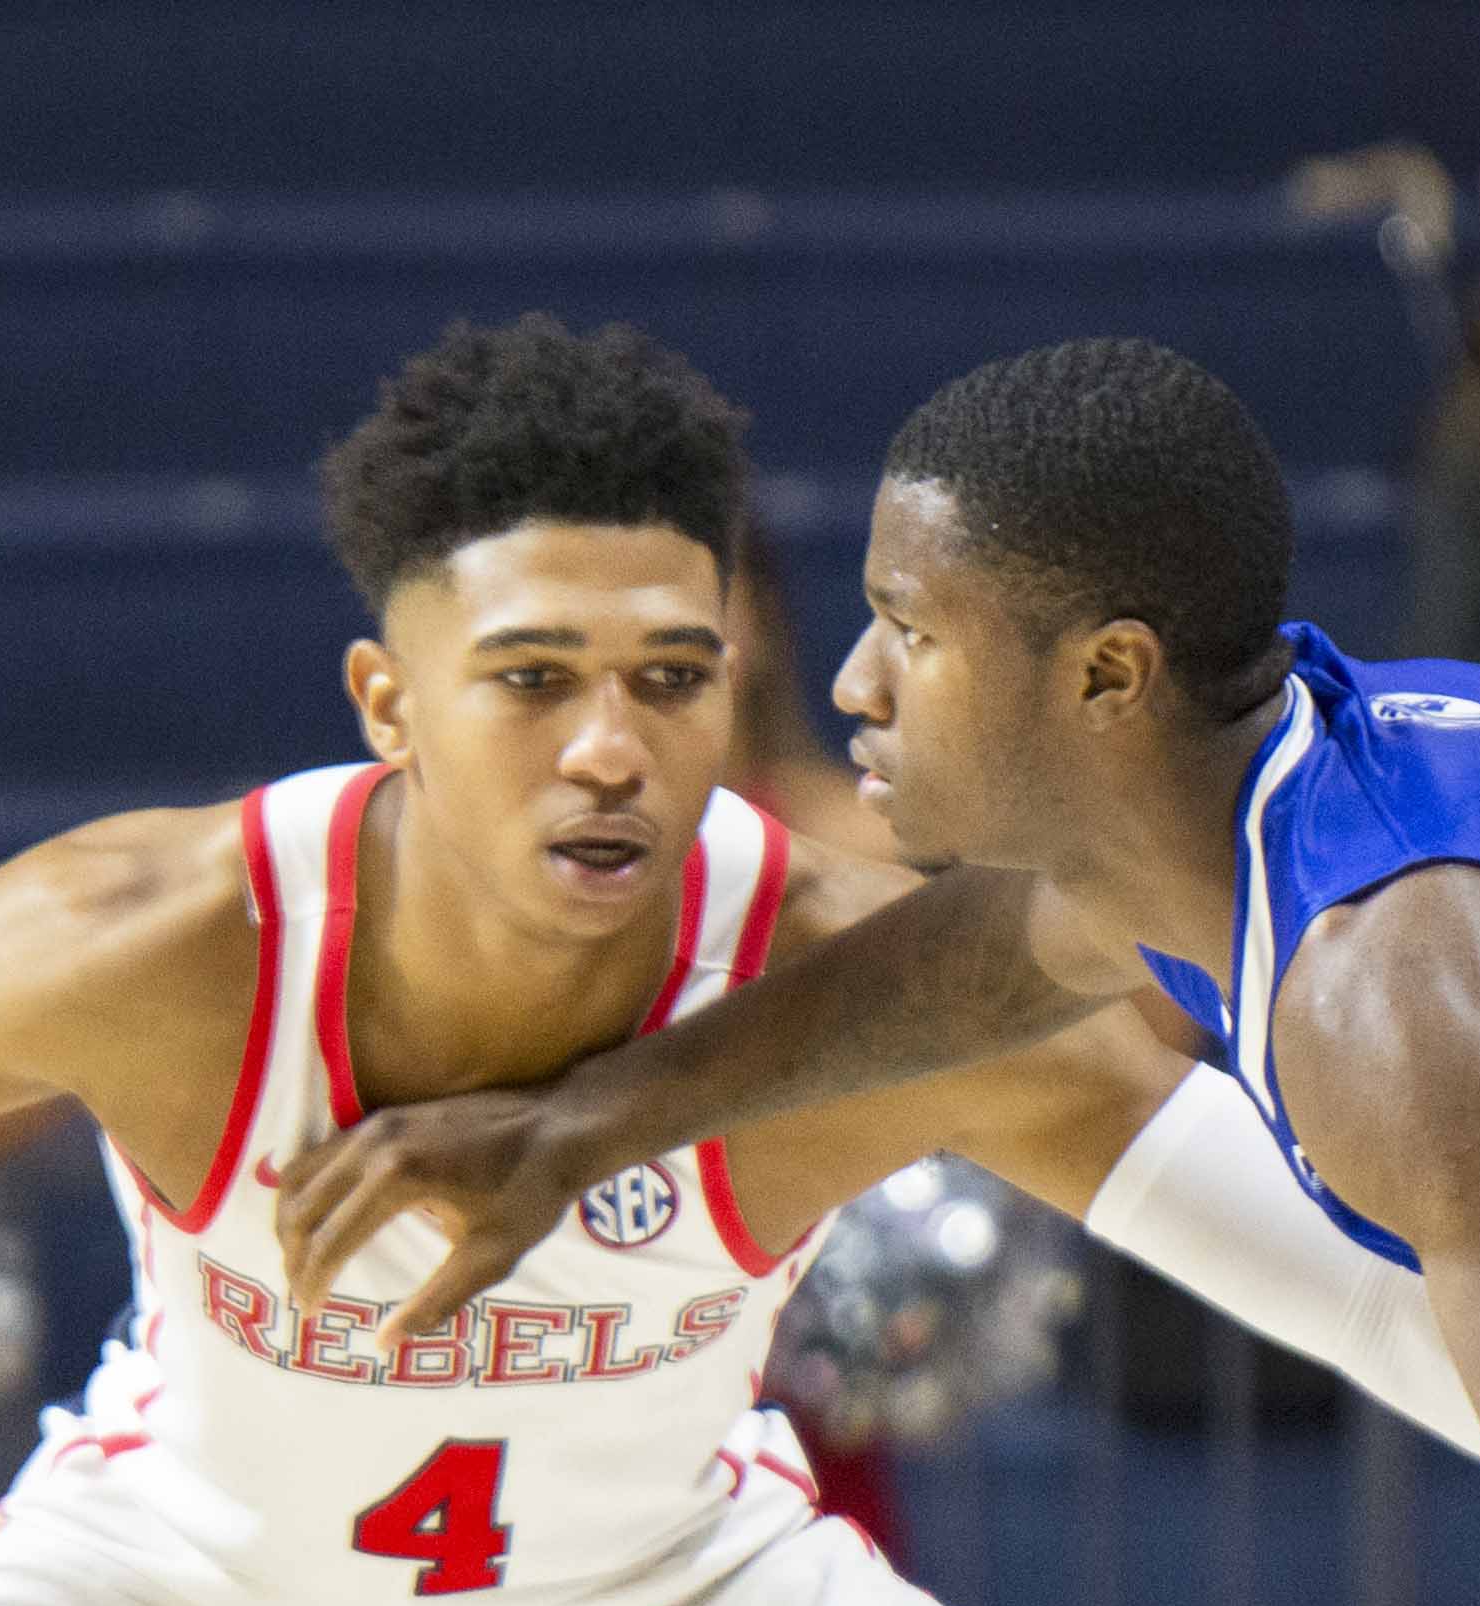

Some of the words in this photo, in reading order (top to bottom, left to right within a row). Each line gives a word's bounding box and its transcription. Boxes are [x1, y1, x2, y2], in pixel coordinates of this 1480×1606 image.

[581, 1163, 673, 1243] SEC
[197, 1248, 748, 1389] REBELS
[351, 1437, 514, 1597] 4
